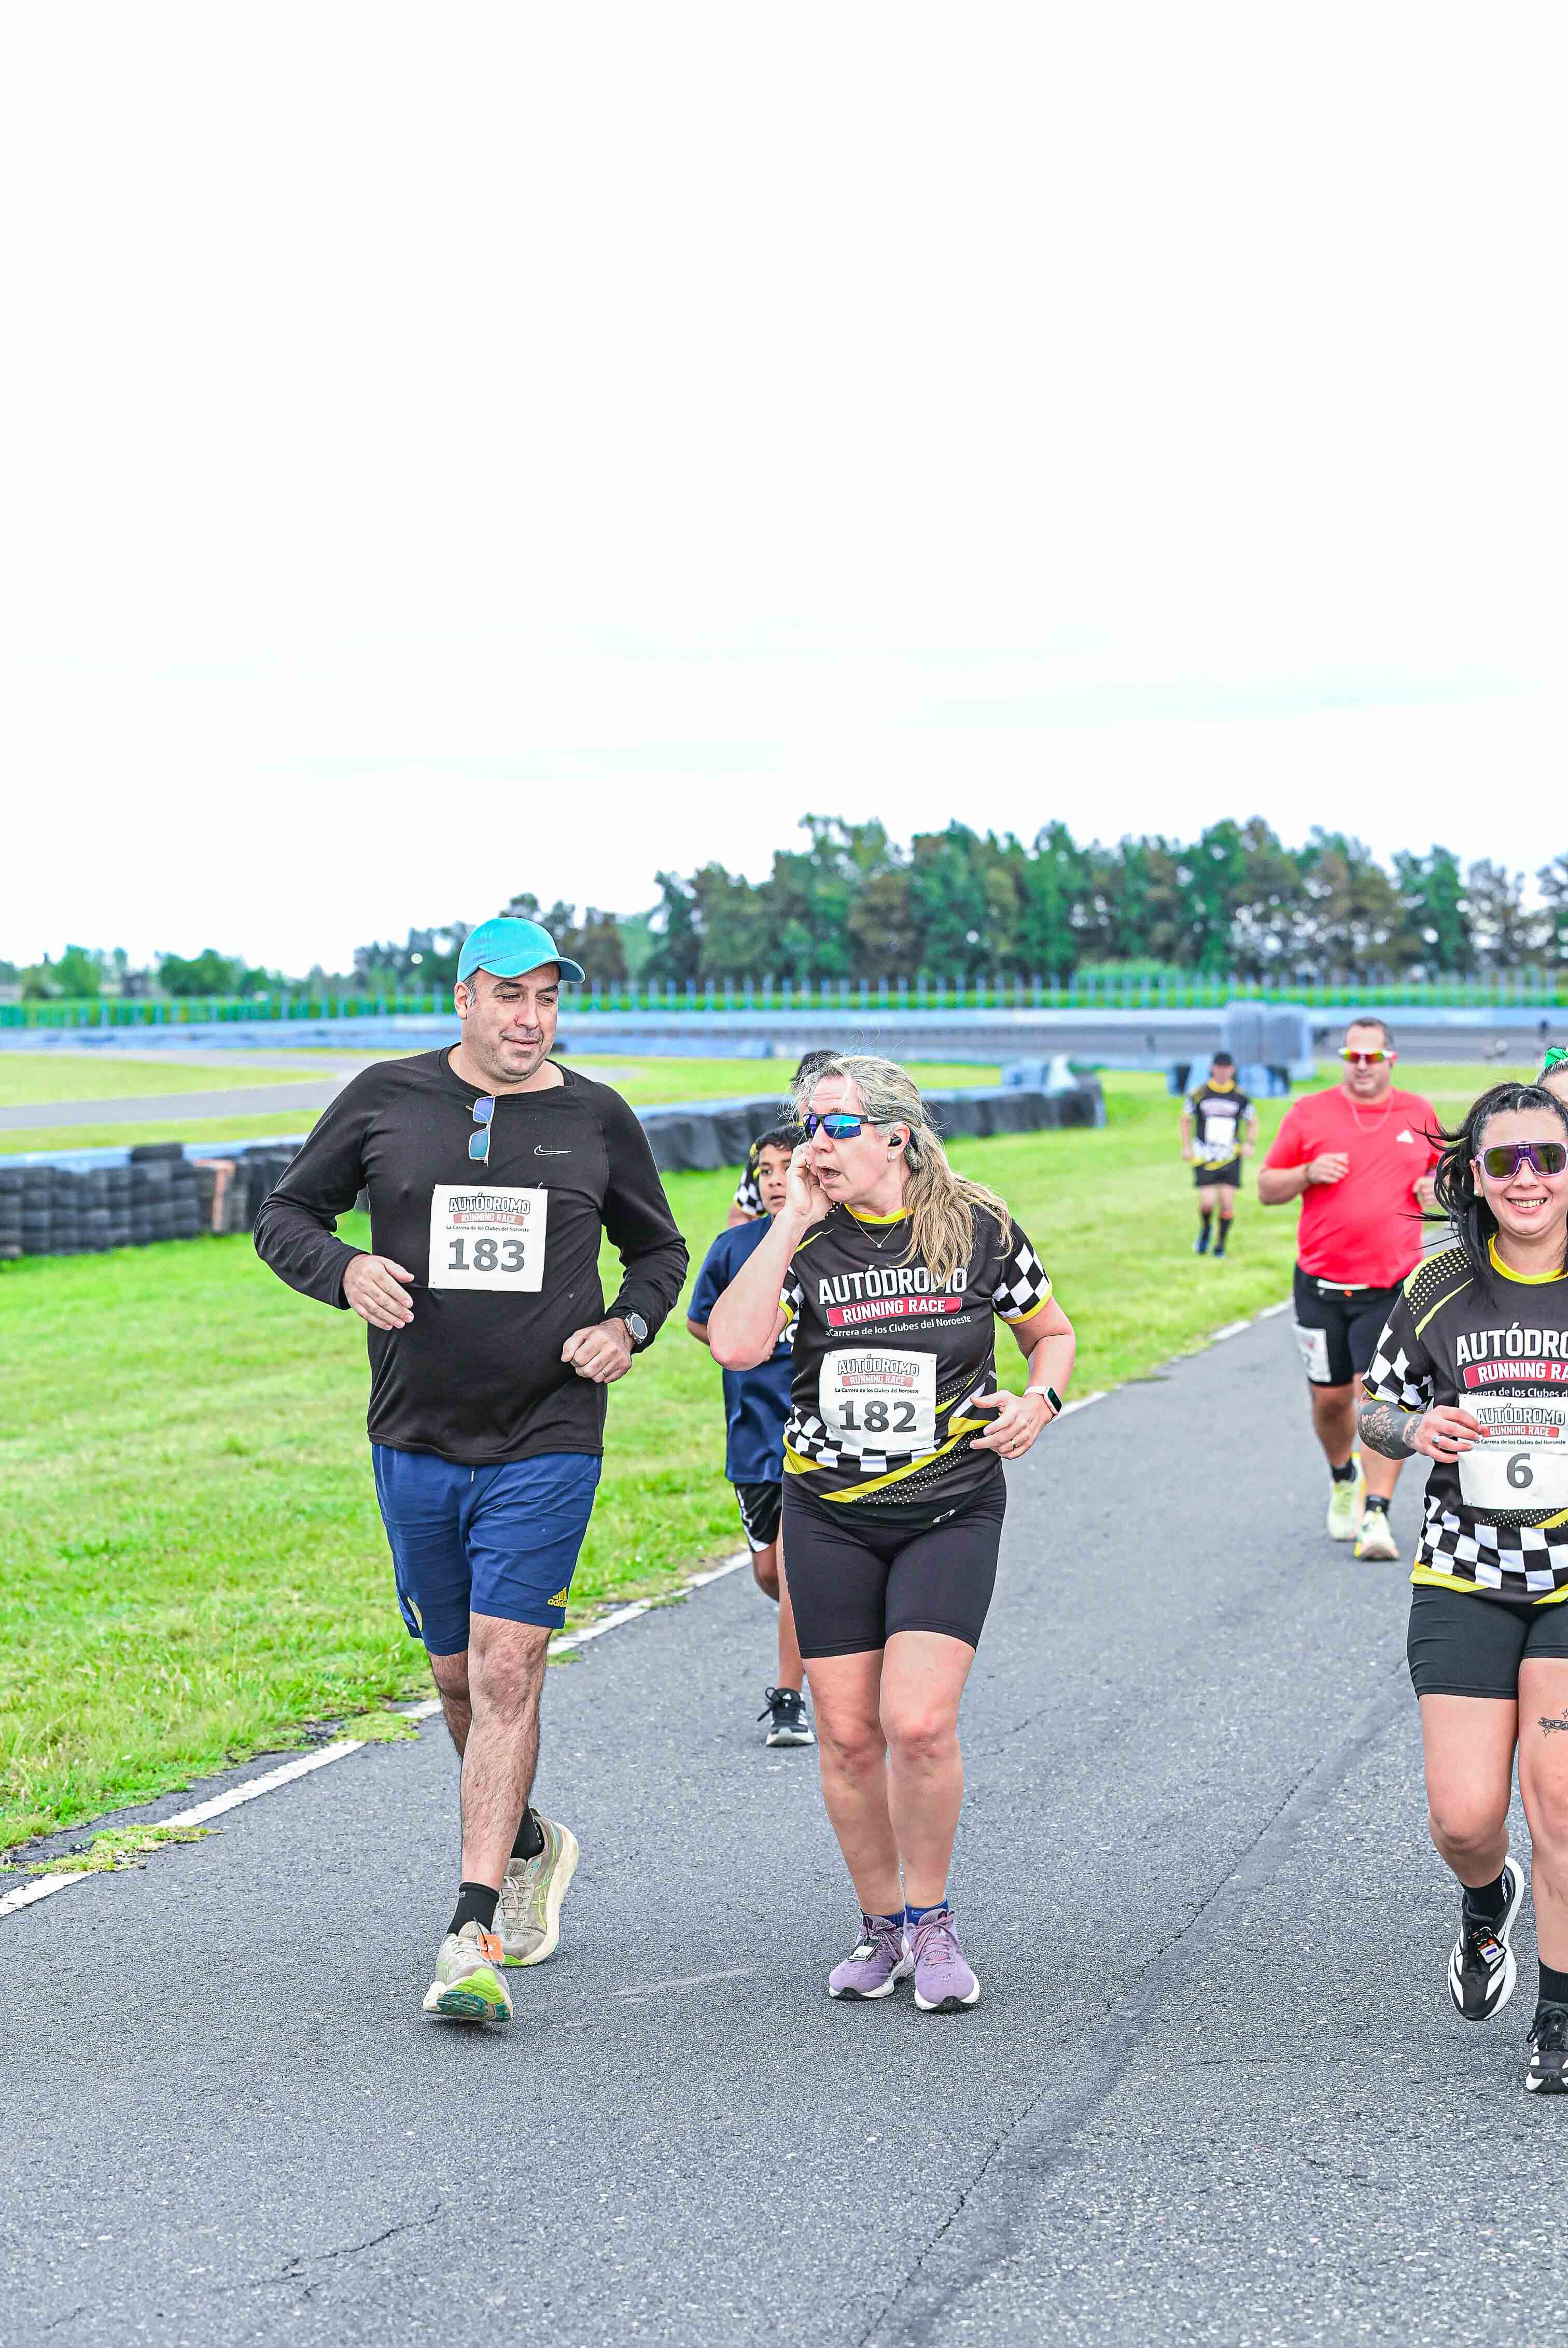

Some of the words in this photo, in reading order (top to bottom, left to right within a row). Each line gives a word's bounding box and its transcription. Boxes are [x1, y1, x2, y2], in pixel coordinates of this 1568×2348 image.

[449, 1193, 530, 1214] AUTÓDROMO
[461, 1212, 494, 1222] RUNNING
[496, 1213, 515, 1223] RACE
[449, 1238, 525, 1272] 183
[842, 1299, 904, 1324] RUNNING
[908, 1299, 946, 1312] RACE
[829, 1329, 860, 1337] Carrera
[874, 1326, 887, 1334] los
[889, 1322, 919, 1333] Clubes
[920, 1319, 934, 1329] del
[936, 1315, 971, 1327] Noroeste
[838, 1354, 919, 1376] AUTÓDROMO
[1477, 1362, 1546, 1383] RUNNING
[850, 1375, 884, 1385] RUNNING
[885, 1376, 905, 1385] RACE
[1499, 1387, 1510, 1396] de
[1512, 1387, 1525, 1397] los
[1528, 1388, 1559, 1397] Clubes
[838, 1401, 917, 1433] 182
[1477, 1403, 1565, 1426] AUTÓDROMO
[1489, 1426, 1526, 1436] RUNNING
[1528, 1427, 1550, 1436] RACE
[1506, 1453, 1533, 1489] 6
